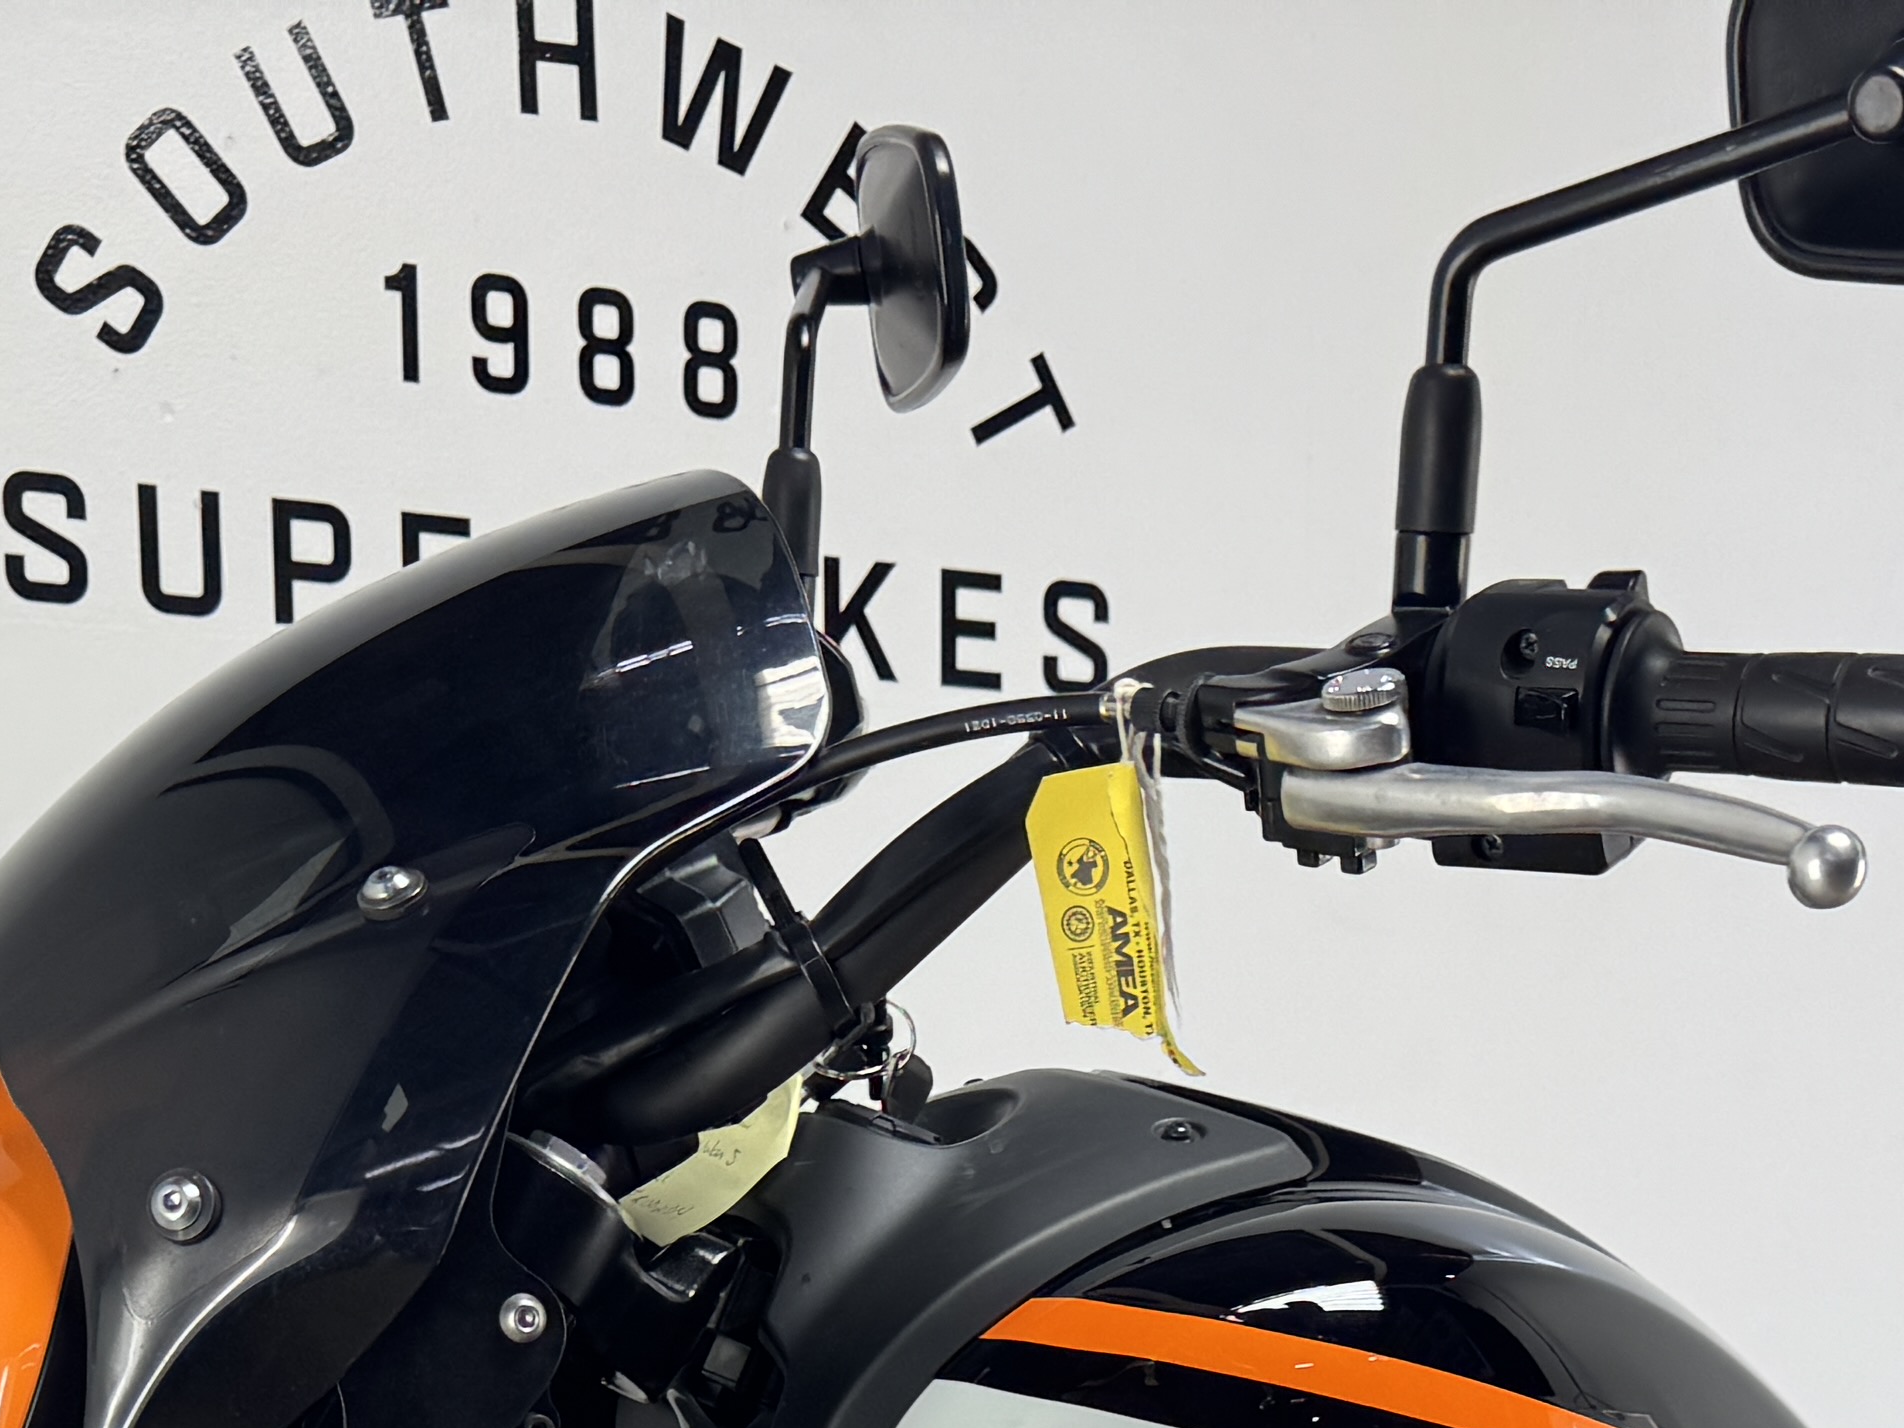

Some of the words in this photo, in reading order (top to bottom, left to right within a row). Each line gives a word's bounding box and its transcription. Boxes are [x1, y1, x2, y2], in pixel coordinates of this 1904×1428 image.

[383, 262, 740, 420] 1988
[1545, 656, 1578, 669] PASS
[1106, 906, 1139, 1017] AMEA
